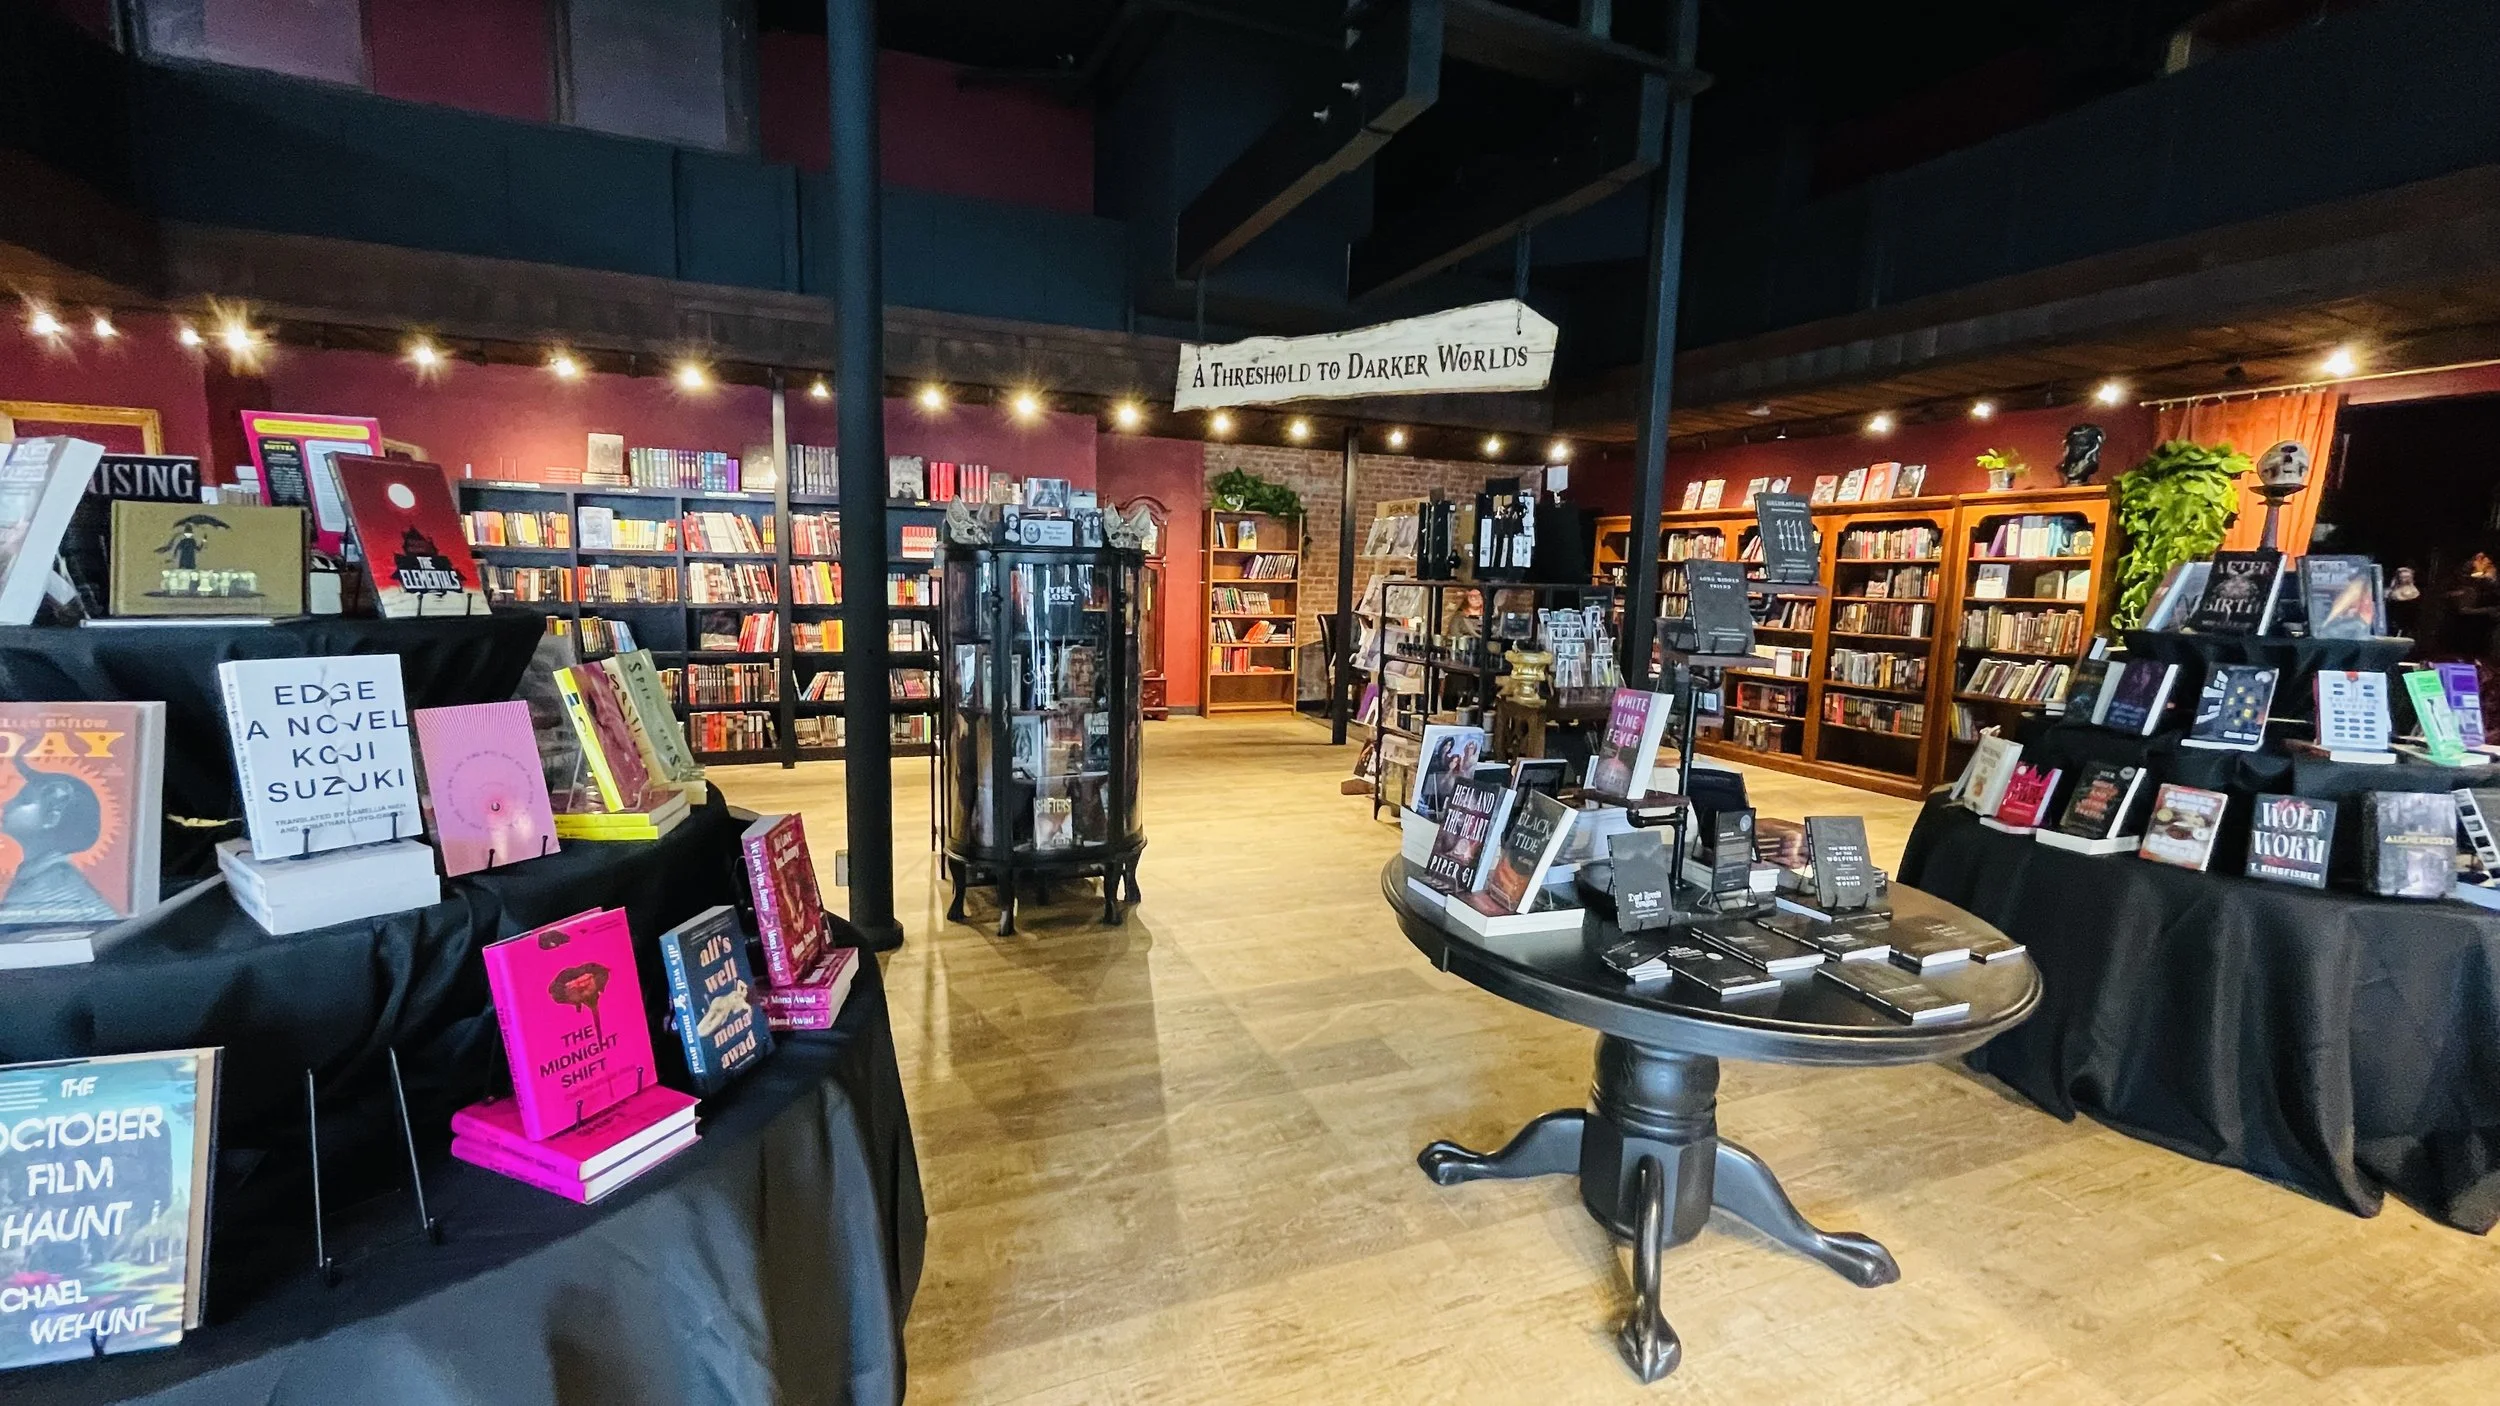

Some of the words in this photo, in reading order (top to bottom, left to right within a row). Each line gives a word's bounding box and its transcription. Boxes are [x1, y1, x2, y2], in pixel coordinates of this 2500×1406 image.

[1192, 363, 1205, 388] A
[1210, 361, 1311, 388] THRESHOLD
[1317, 361, 1341, 381] TO
[1348, 351, 1430, 380] DARKER
[1438, 343, 1529, 373] WORLDS
[416, 556, 435, 570] THE
[399, 569, 461, 589] ELEMENTALS
[274, 681, 377, 705] EDGE
[1617, 694, 1648, 712] WHITE
[246, 720, 269, 741] A
[287, 709, 408, 737] NOVEL
[1616, 711, 1640, 730] LINE
[1606, 728, 1639, 748] FEVER
[292, 741, 375, 768] KOJI
[268, 768, 404, 803] SUZUKI
[1451, 784, 1475, 809] HELL
[1476, 791, 1495, 814] AND
[1036, 799, 1071, 814] SHIFTERS
[2262, 802, 2326, 833] WOLF
[279, 825, 299, 834] AND
[1443, 808, 1463, 835] THE
[1460, 814, 1488, 843] HEART
[1517, 812, 1553, 840] BLACK
[1515, 832, 1539, 854] TIDE
[2253, 830, 2326, 864] WORM
[1430, 855, 1459, 878] PIPER
[2260, 865, 2322, 882] KINGFISHER
[700, 934, 732, 967] all's
[704, 958, 738, 994] well
[792, 995, 816, 1004] Awad
[673, 967, 687, 990] well
[682, 1014, 695, 1044] mona
[689, 1045, 705, 1075] awad
[713, 1011, 752, 1049] mona
[791, 1015, 814, 1025] Awad
[561, 1024, 594, 1047] THE
[721, 1031, 757, 1069] awad
[539, 1033, 618, 1078] MIDNIGHT
[61, 1076, 99, 1098] THE
[560, 1057, 607, 1089] SHIFT
[0, 1105, 164, 1157] CTOBER
[27, 1156, 114, 1196] FILM
[2, 1201, 132, 1248] HAUNT
[30, 1303, 154, 1345] WEHUNT
